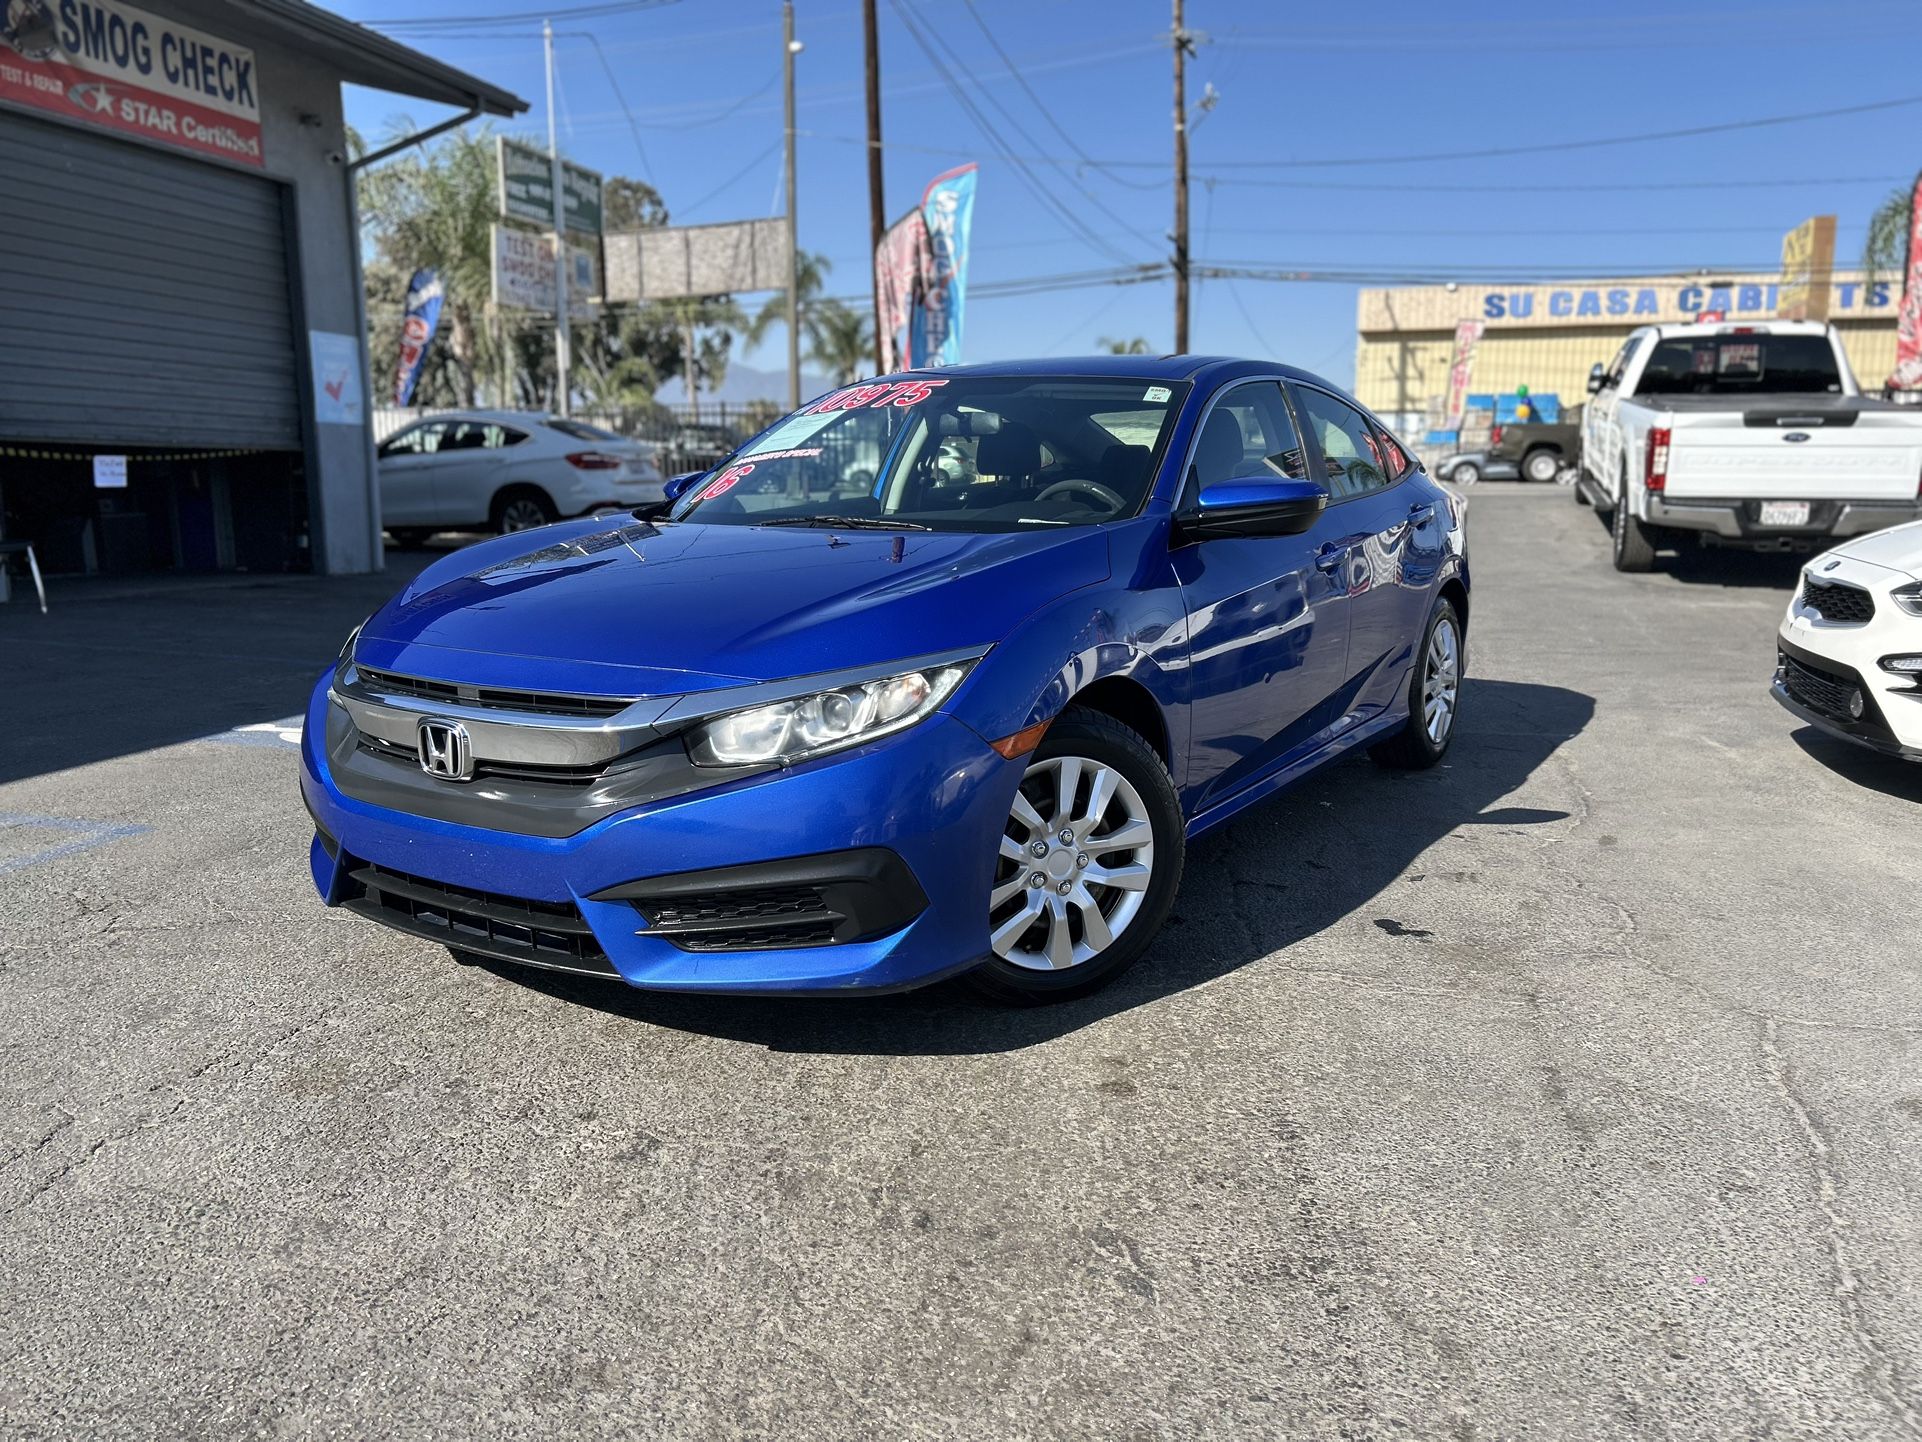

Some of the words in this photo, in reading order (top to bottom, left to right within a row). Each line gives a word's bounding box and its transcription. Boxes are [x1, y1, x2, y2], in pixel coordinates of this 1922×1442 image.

[60, 0, 152, 75] SMOG
[161, 32, 255, 109] CHECK
[120, 98, 178, 135] STAR
[1484, 292, 1533, 318] SU
[1549, 288, 1659, 316] CASA
[1678, 282, 1891, 312] CABITS
[690, 464, 756, 504] 16
